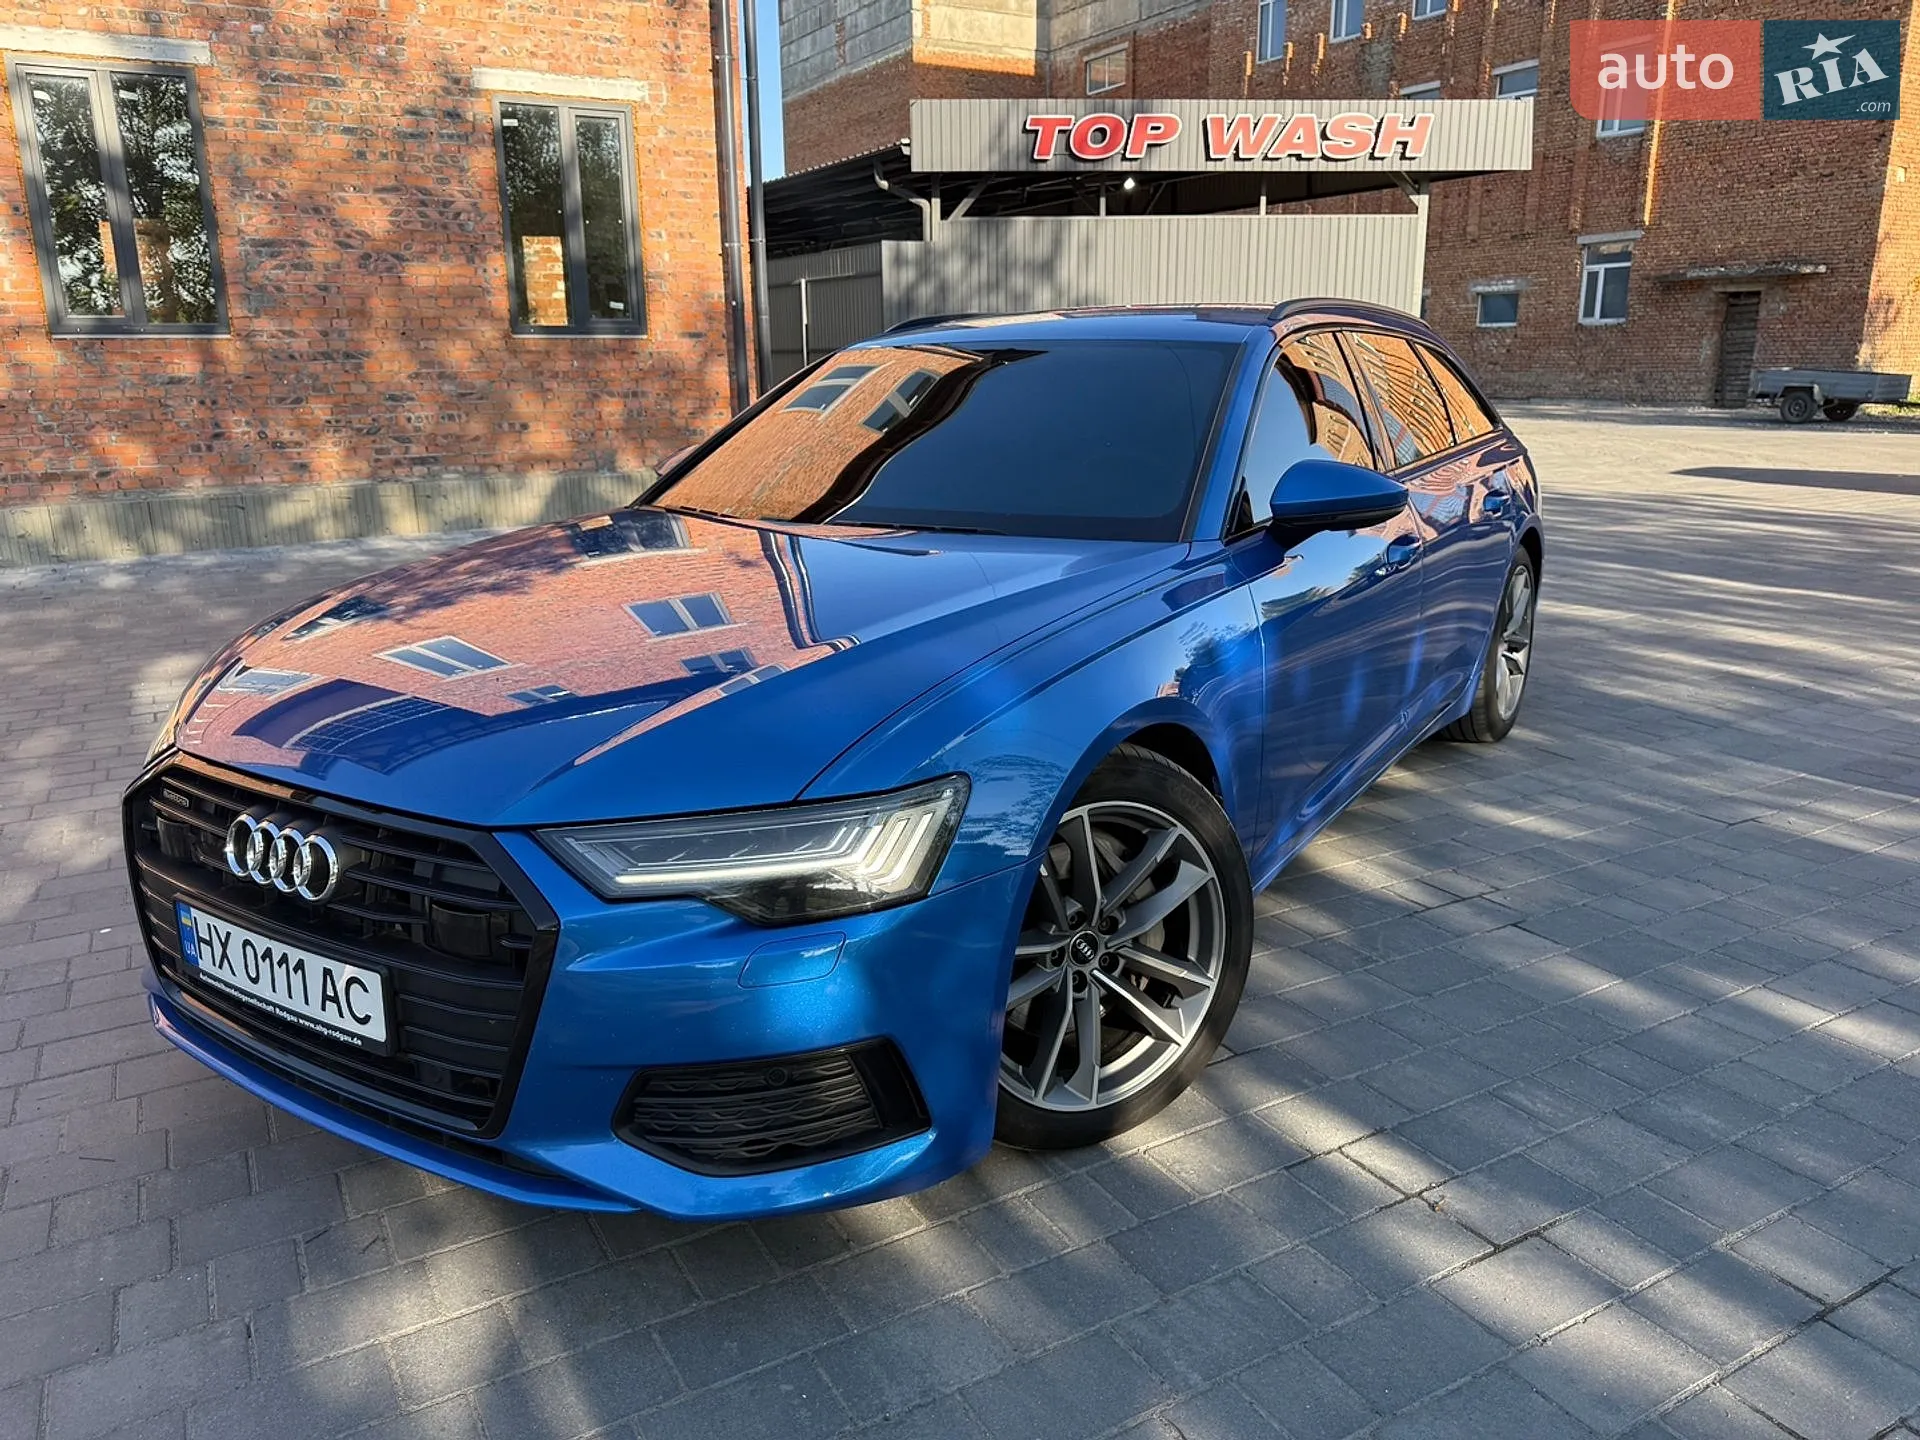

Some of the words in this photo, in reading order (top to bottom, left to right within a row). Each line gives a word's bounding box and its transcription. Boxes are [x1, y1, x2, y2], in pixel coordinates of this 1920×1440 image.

[1025, 113, 1182, 160] TOP
[1204, 113, 1435, 160] WASH
[184, 940, 198, 958] UA
[193, 915, 237, 977] HX
[241, 938, 310, 1006] 0111
[320, 966, 372, 1026] AC
